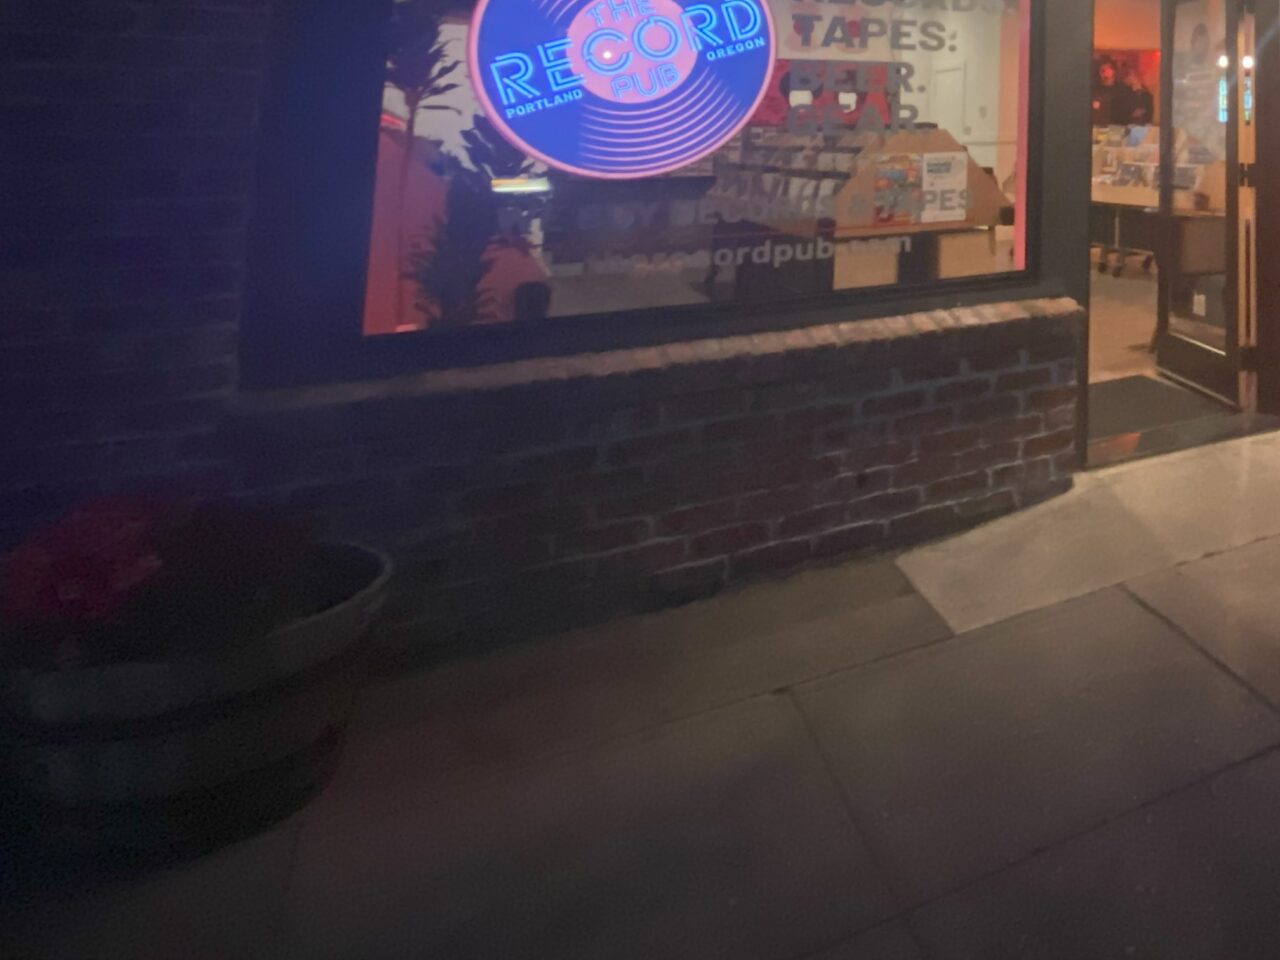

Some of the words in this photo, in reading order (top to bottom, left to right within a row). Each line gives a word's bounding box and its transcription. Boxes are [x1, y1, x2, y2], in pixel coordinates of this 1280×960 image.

[505, 88, 584, 119] PORTLAND
[706, 37, 765, 61] OREGON
[610, 63, 681, 101] PUB
